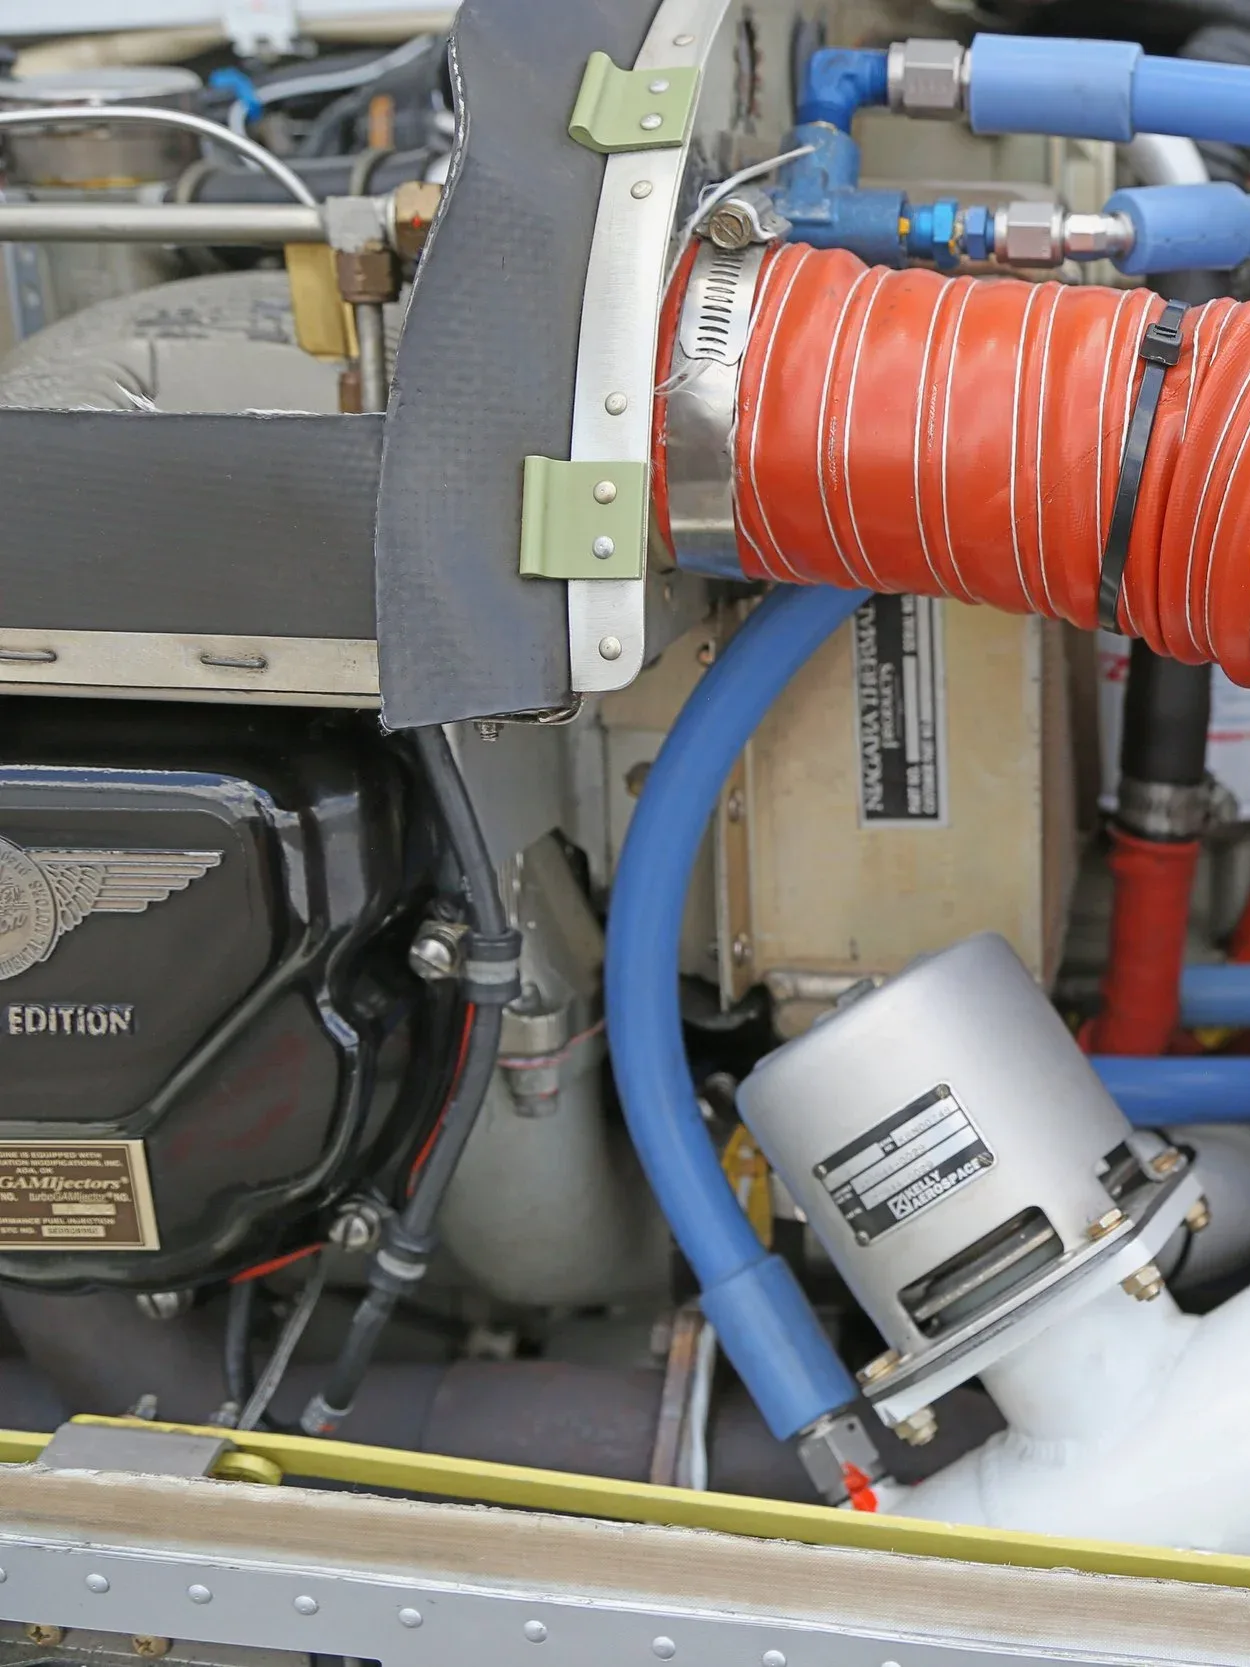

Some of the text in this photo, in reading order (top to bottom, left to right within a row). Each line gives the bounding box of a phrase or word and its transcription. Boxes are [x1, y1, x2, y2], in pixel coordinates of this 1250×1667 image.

[863, 711, 884, 812] NIAGARA
[8, 1004, 134, 1036] EDITION
[904, 1169, 941, 1200] KELLY
[910, 1158, 981, 1210] AEROSPACE
